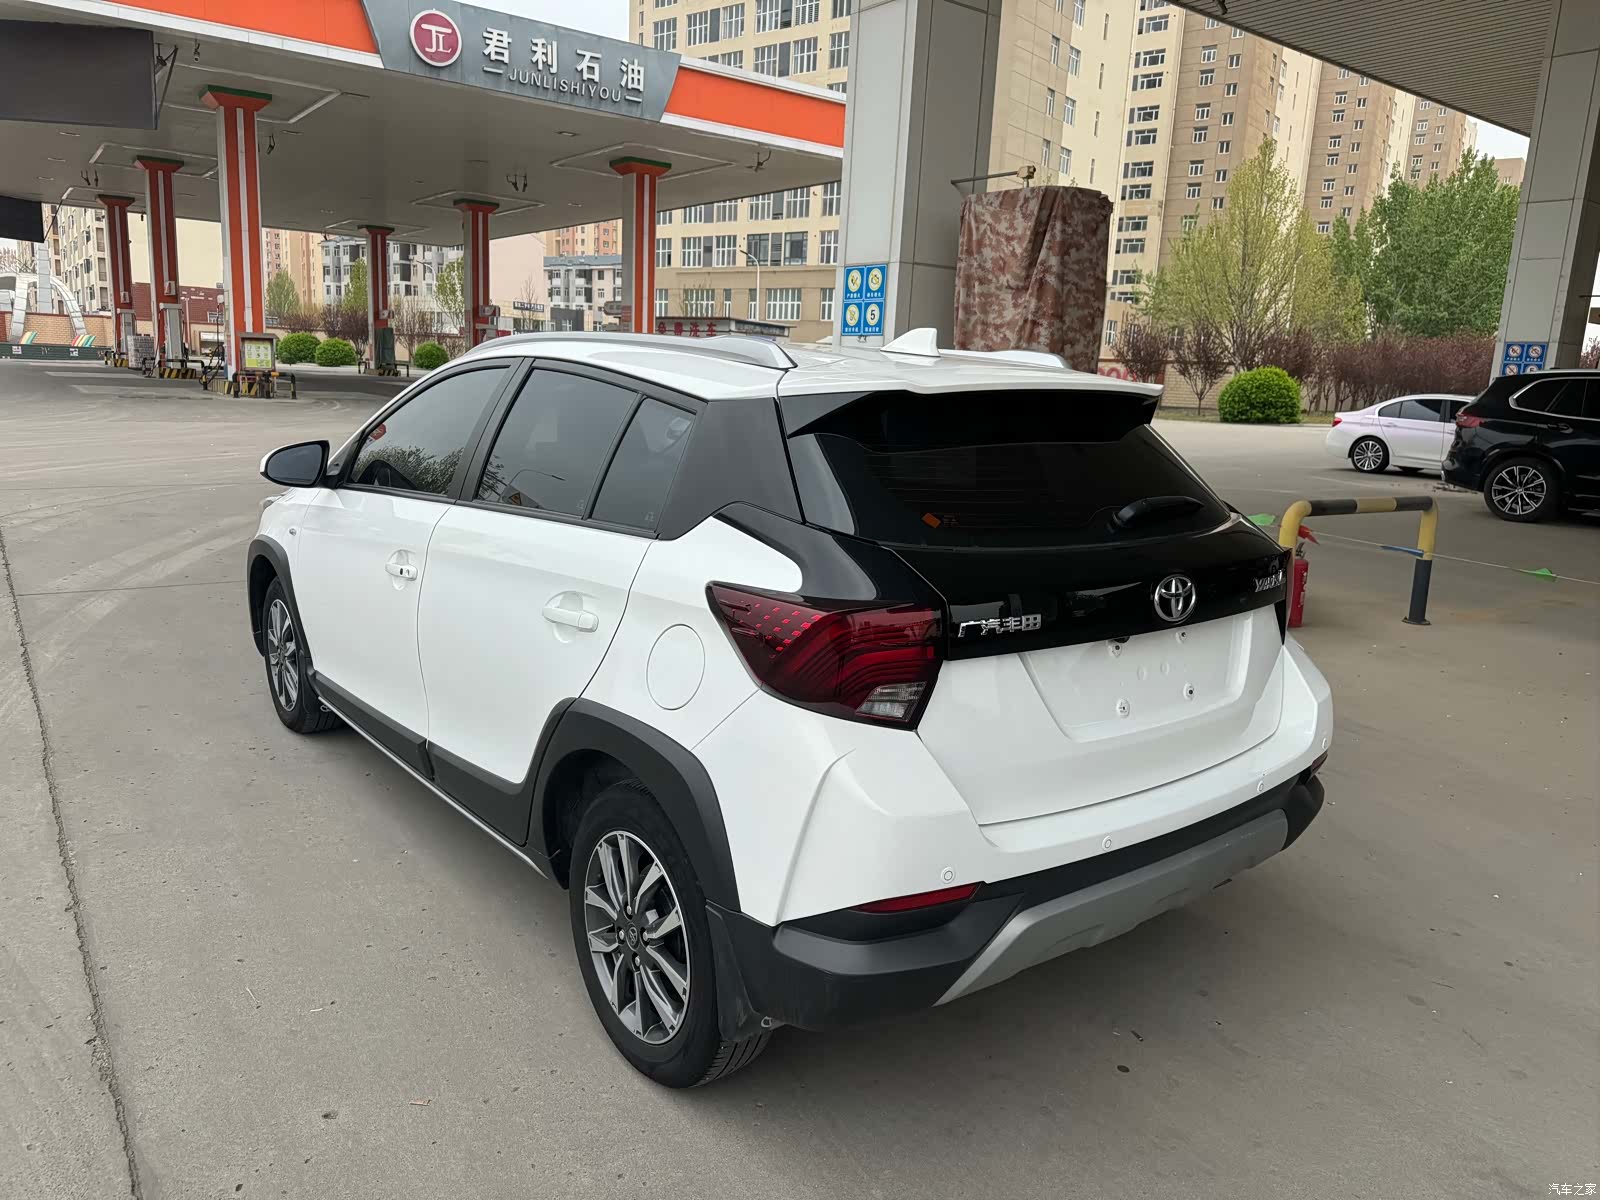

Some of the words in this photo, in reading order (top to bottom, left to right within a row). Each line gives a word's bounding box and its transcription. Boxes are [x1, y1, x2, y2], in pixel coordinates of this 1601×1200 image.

[482, 27, 645, 93] 君利石油
[508, 67, 622, 103] JUNLISHIYOU
[957, 613, 1042, 638] 广汽丰田
